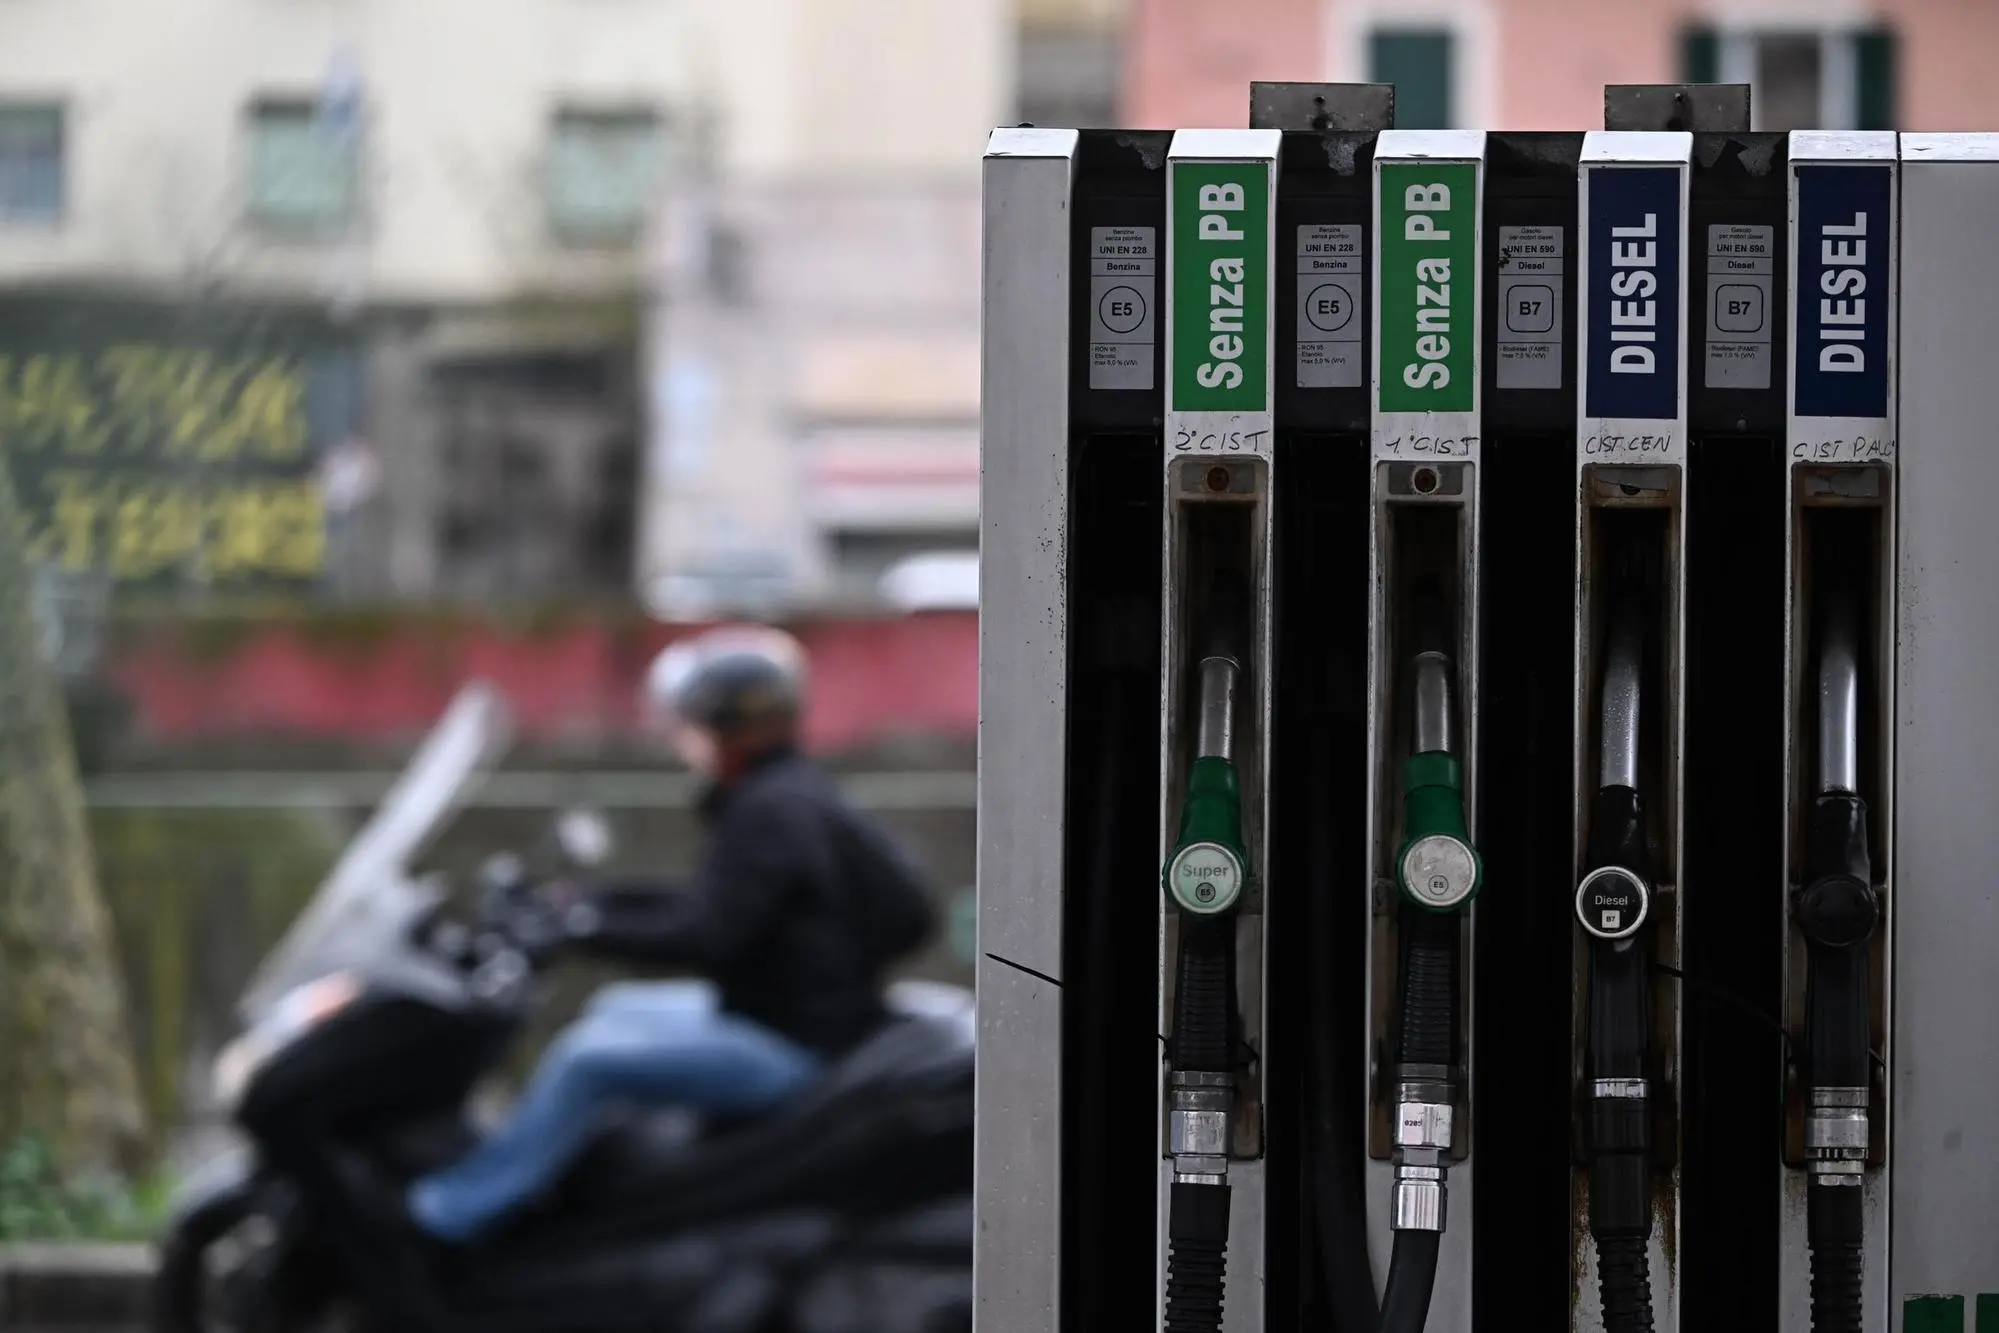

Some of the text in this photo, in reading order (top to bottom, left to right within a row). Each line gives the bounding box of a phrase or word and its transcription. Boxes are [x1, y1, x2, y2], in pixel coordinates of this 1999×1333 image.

[1099, 246, 1147, 254] UNI EN 228
[1305, 244, 1354, 252] UNI EN 228
[1506, 245, 1555, 253] UNI EN 590
[1716, 244, 1765, 253] UNI EN 590
[1106, 262, 1141, 271] Benzina
[1312, 260, 1348, 269] Benzina
[1518, 261, 1545, 270] Diesel
[1727, 260, 1755, 269] Diesel
[1197, 183, 1245, 389] Senza PB
[1403, 183, 1450, 389] Senza PB
[1610, 213, 1657, 373] DIESEL
[1819, 212, 1867, 372] DIESEL
[1111, 301, 1133, 316] E5
[1318, 300, 1340, 315] E5
[1519, 301, 1542, 316] B7
[1728, 300, 1751, 316] B7
[1792, 440, 1843, 458] CIST
[1182, 864, 1229, 880] Super
[1200, 888, 1211, 896] E5
[1595, 895, 1628, 906] Diesel
[1606, 915, 1616, 923] B7
